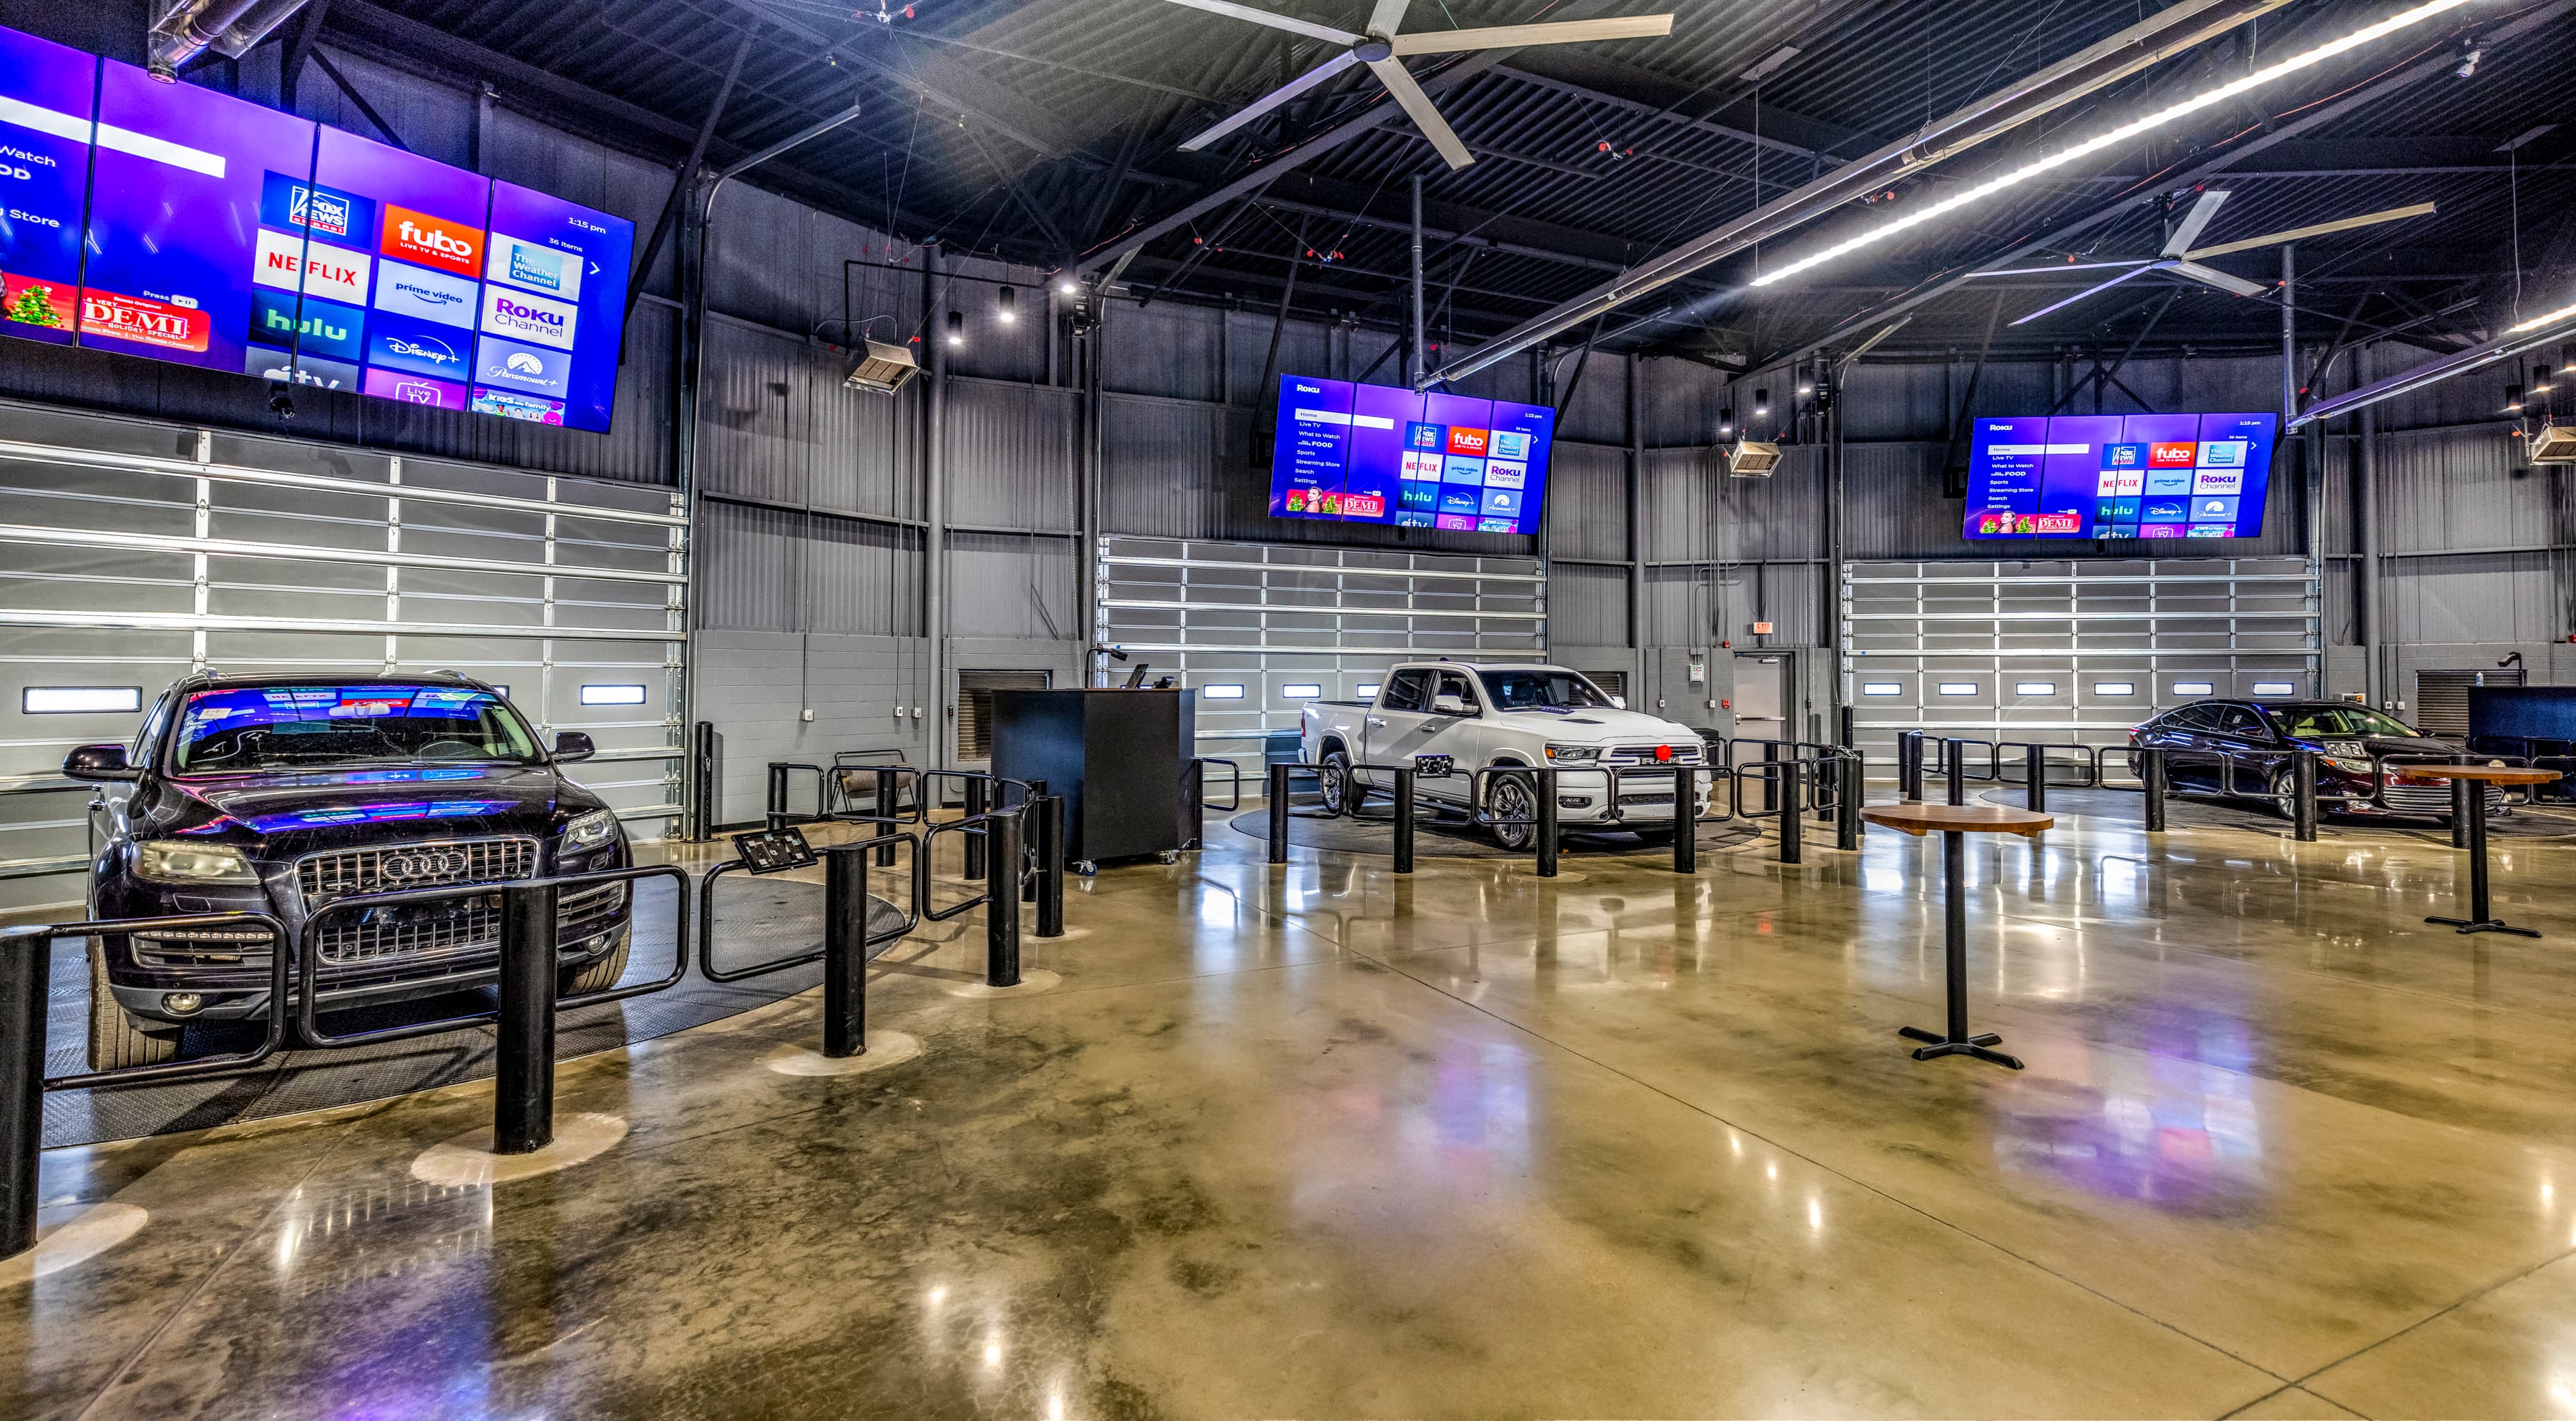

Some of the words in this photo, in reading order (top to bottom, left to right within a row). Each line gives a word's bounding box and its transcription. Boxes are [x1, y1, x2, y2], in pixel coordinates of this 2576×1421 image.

[9, 209, 60, 228] Store
[568, 217, 588, 228] 1:15
[590, 225, 606, 234] pm
[399, 220, 472, 256] fubo
[548, 237, 559, 245] 36
[400, 242, 417, 250] LIVE
[440, 253, 470, 264] SPORTS
[514, 253, 535, 264] The
[268, 252, 356, 286] NEFLIX
[513, 260, 559, 280] Weather
[512, 270, 557, 288] Channel
[143, 290, 170, 301] Press
[396, 283, 430, 296] prime
[432, 292, 463, 303] video
[96, 298, 118, 308] VERY
[135, 300, 162, 310] Original
[84, 302, 184, 335] DEMI
[497, 298, 565, 327] Roku
[267, 308, 347, 341] hulu
[495, 313, 563, 338] Channel
[108, 322, 143, 333] HOLIDAY
[147, 328, 182, 340] SPECIAL
[407, 387, 431, 396] Live
[1297, 384, 1320, 394] Roku
[407, 393, 430, 404] TV
[1454, 432, 1483, 446] fubo
[2157, 448, 2190, 458] fubo
[1405, 462, 1438, 472] NEFLIX
[1491, 465, 1521, 477] Roku
[1490, 474, 1520, 483] Channel
[2103, 479, 2137, 488] NEFLIX
[2200, 474, 2236, 483] Roku
[1404, 490, 1433, 502] hulu
[1345, 500, 1377, 510] DEMI
[2101, 506, 2133, 515] hulu
